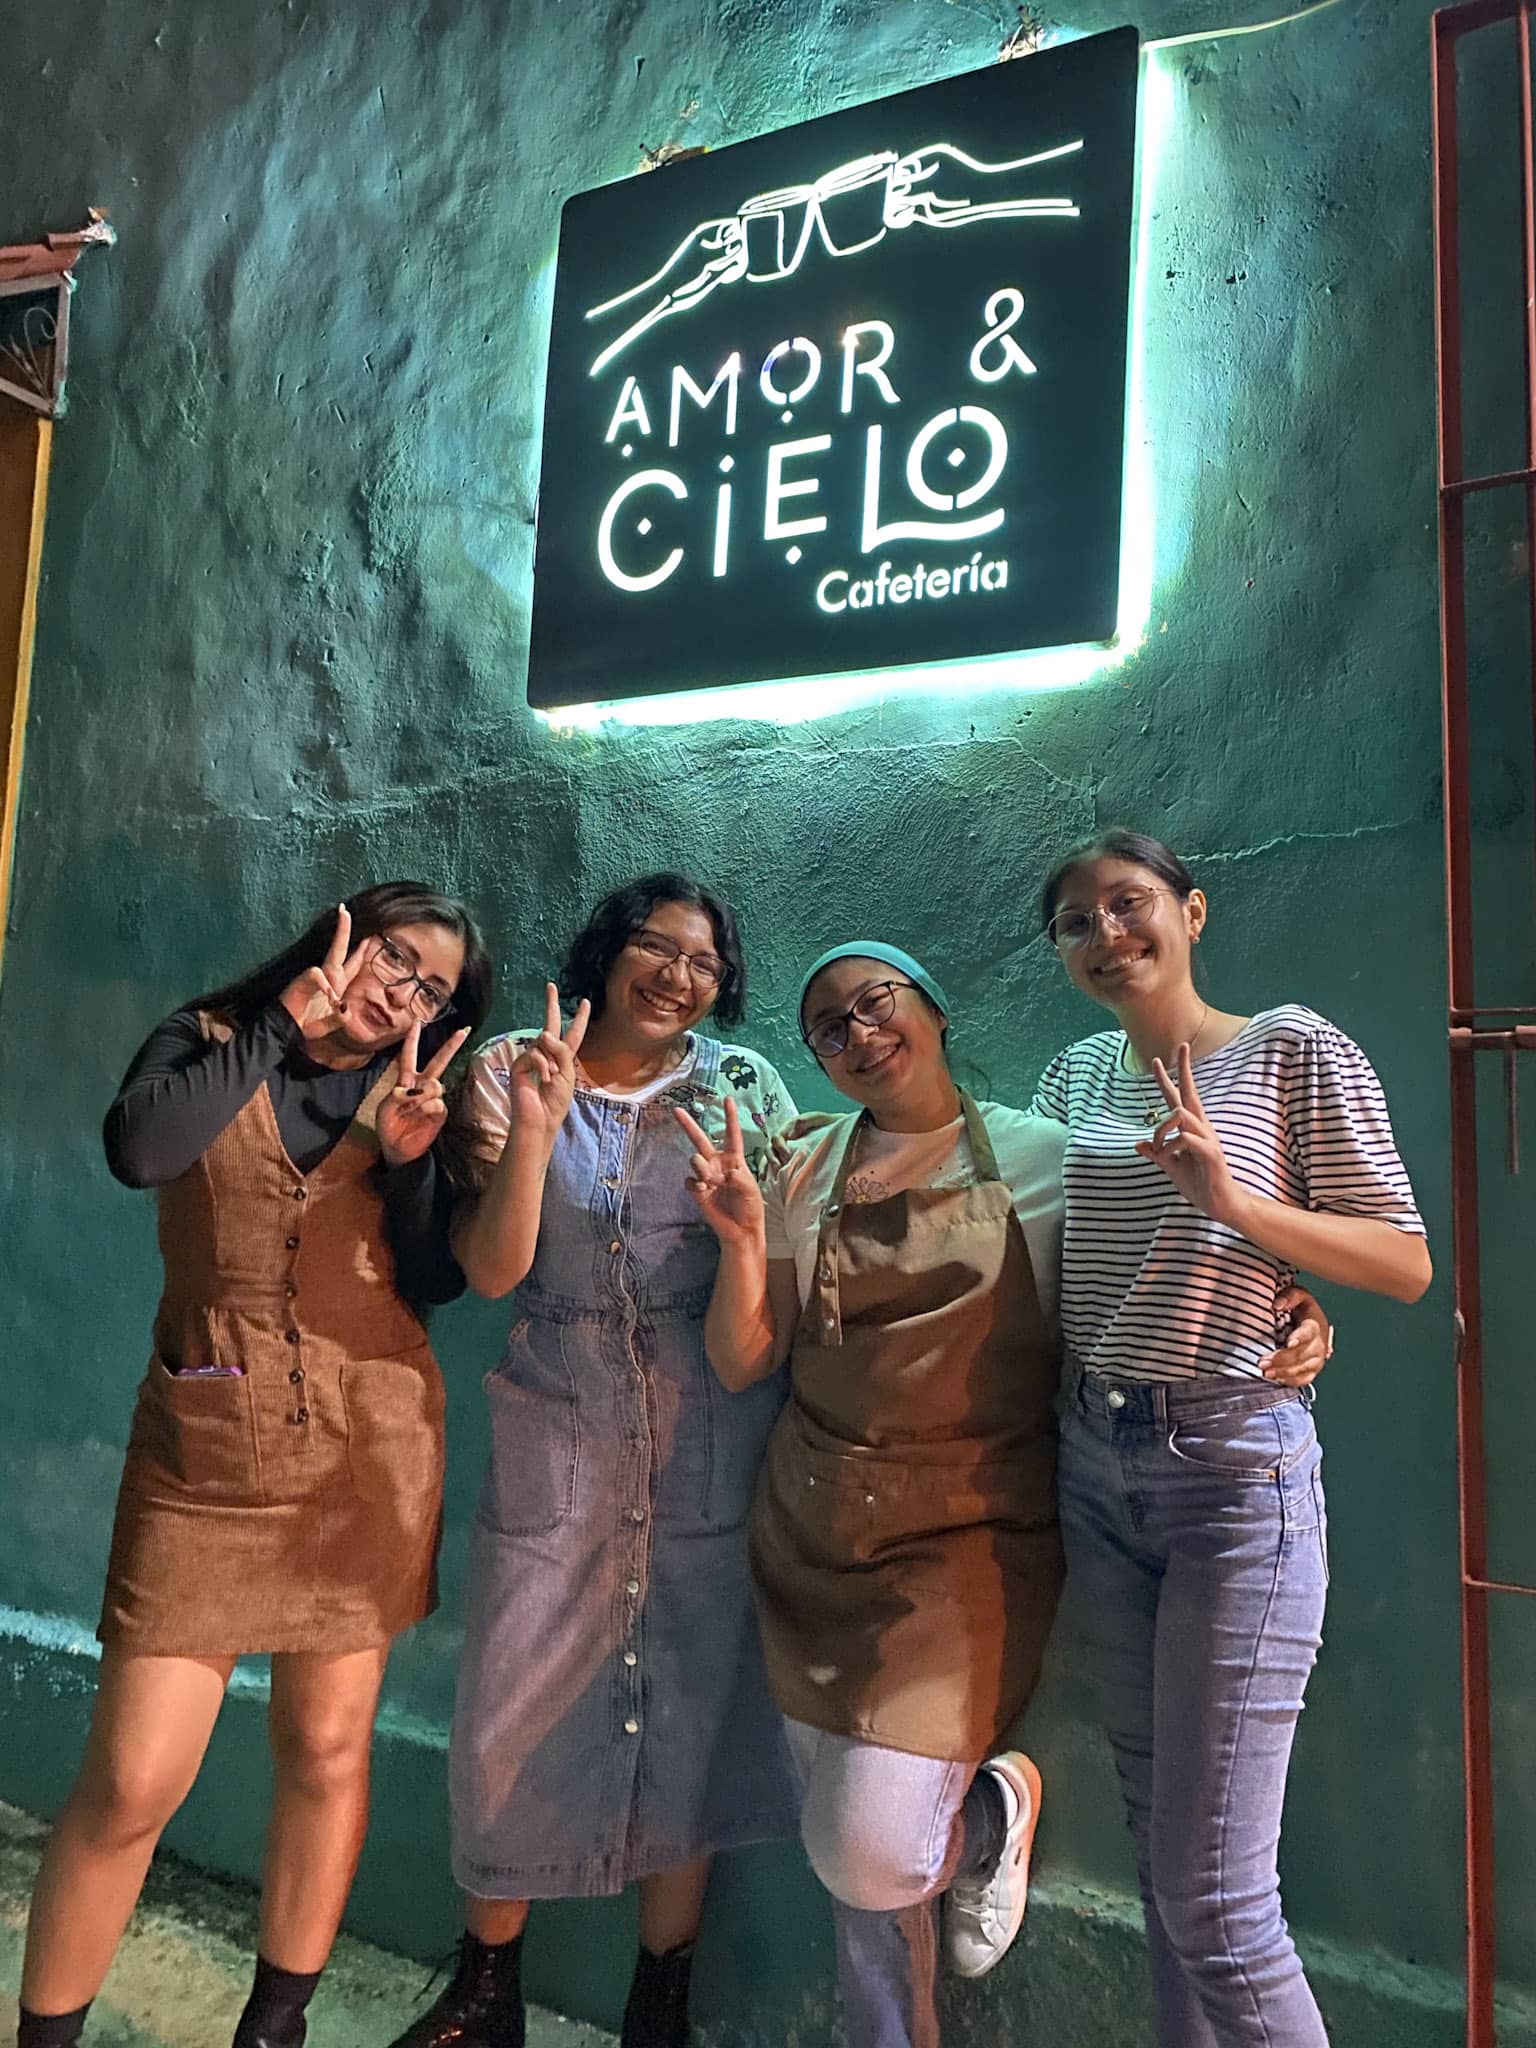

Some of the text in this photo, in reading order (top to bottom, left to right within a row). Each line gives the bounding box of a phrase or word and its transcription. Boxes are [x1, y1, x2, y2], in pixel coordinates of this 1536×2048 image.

[604, 287, 1038, 457] AMOR &
[816, 551, 1009, 614] Cafetería
